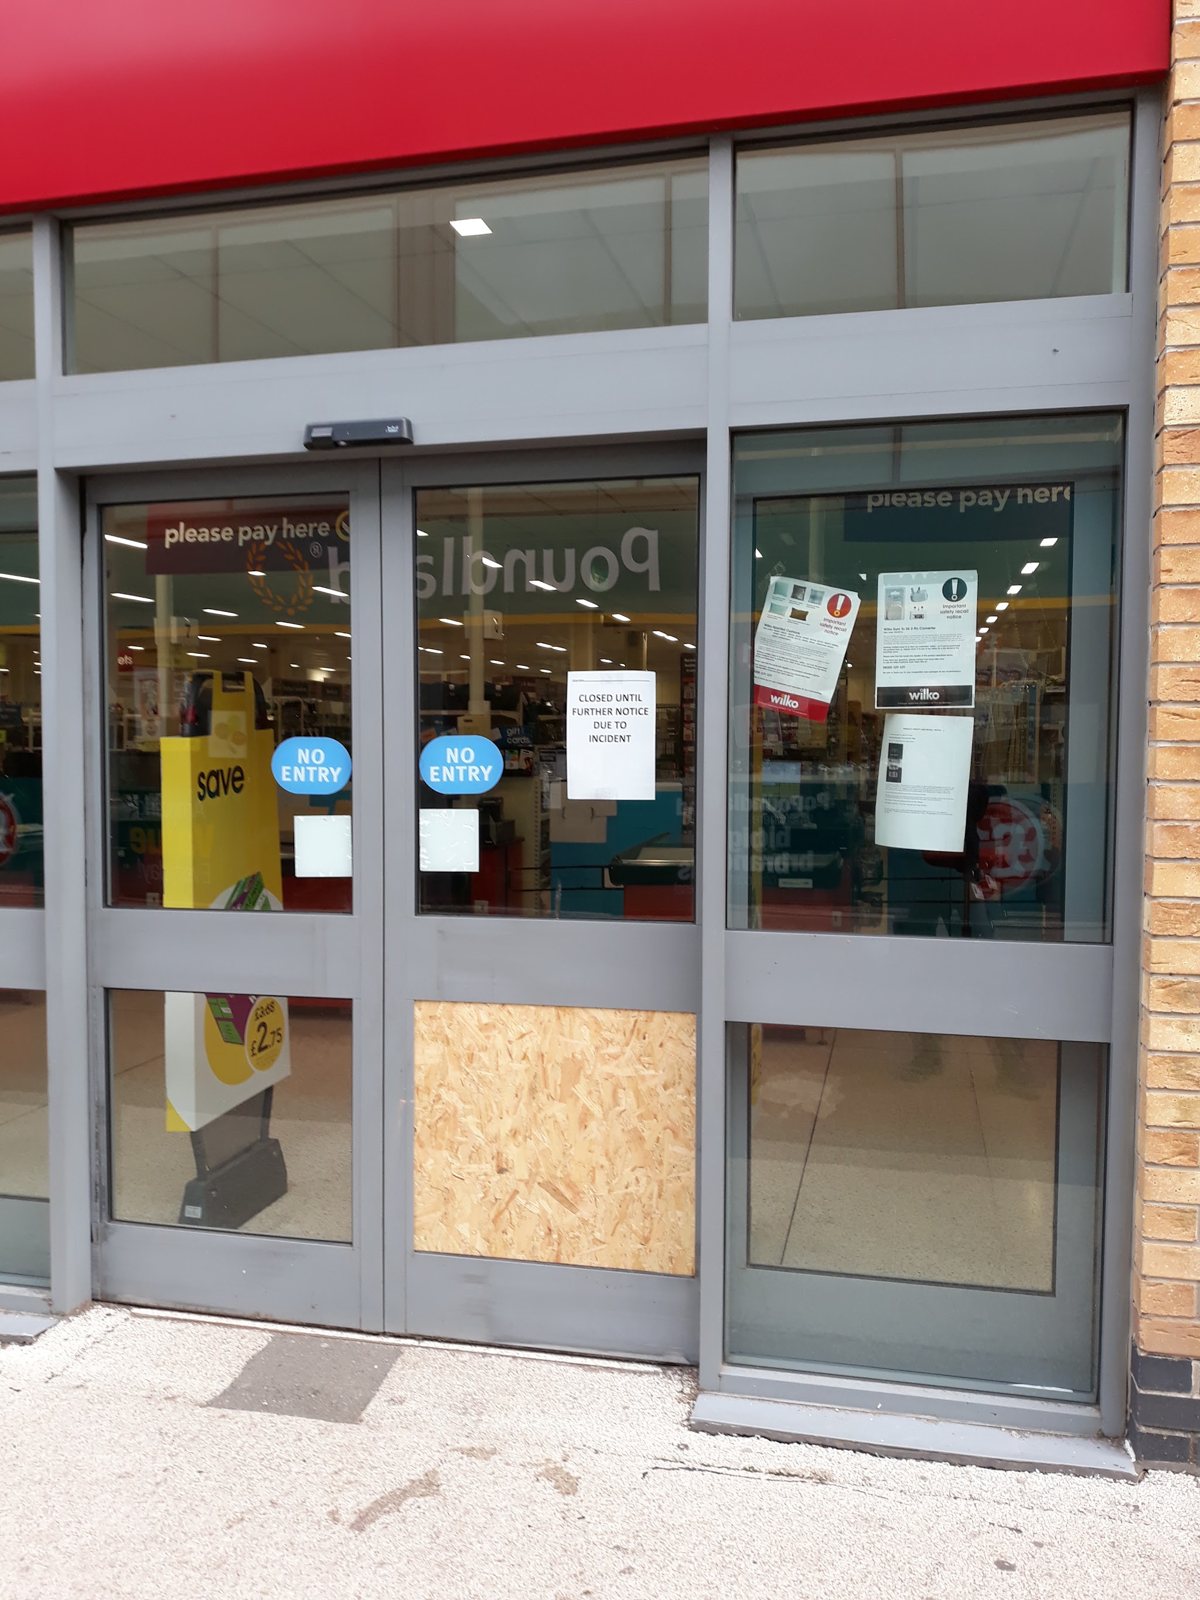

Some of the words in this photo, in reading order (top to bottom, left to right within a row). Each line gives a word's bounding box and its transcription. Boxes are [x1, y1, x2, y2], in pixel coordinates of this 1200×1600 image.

[866, 491, 951, 513] please
[959, 488, 1011, 513] pay
[165, 521, 234, 549] please
[238, 524, 278, 547] pay
[282, 517, 331, 539] here
[578, 693, 613, 703] CLOSED
[615, 693, 643, 702] UNTIL
[770, 692, 799, 709] wilko
[909, 688, 940, 701] wilko
[572, 707, 613, 716] FURTHER
[615, 707, 649, 716] NOTICE
[593, 721, 612, 730] DUE
[615, 721, 628, 729] TO
[589, 735, 632, 743] INCIDENT
[297, 748, 326, 765] NO
[446, 747, 475, 764] NO
[281, 766, 342, 783] ENTRY
[429, 765, 493, 783] ENTRY
[197, 765, 245, 801] save
